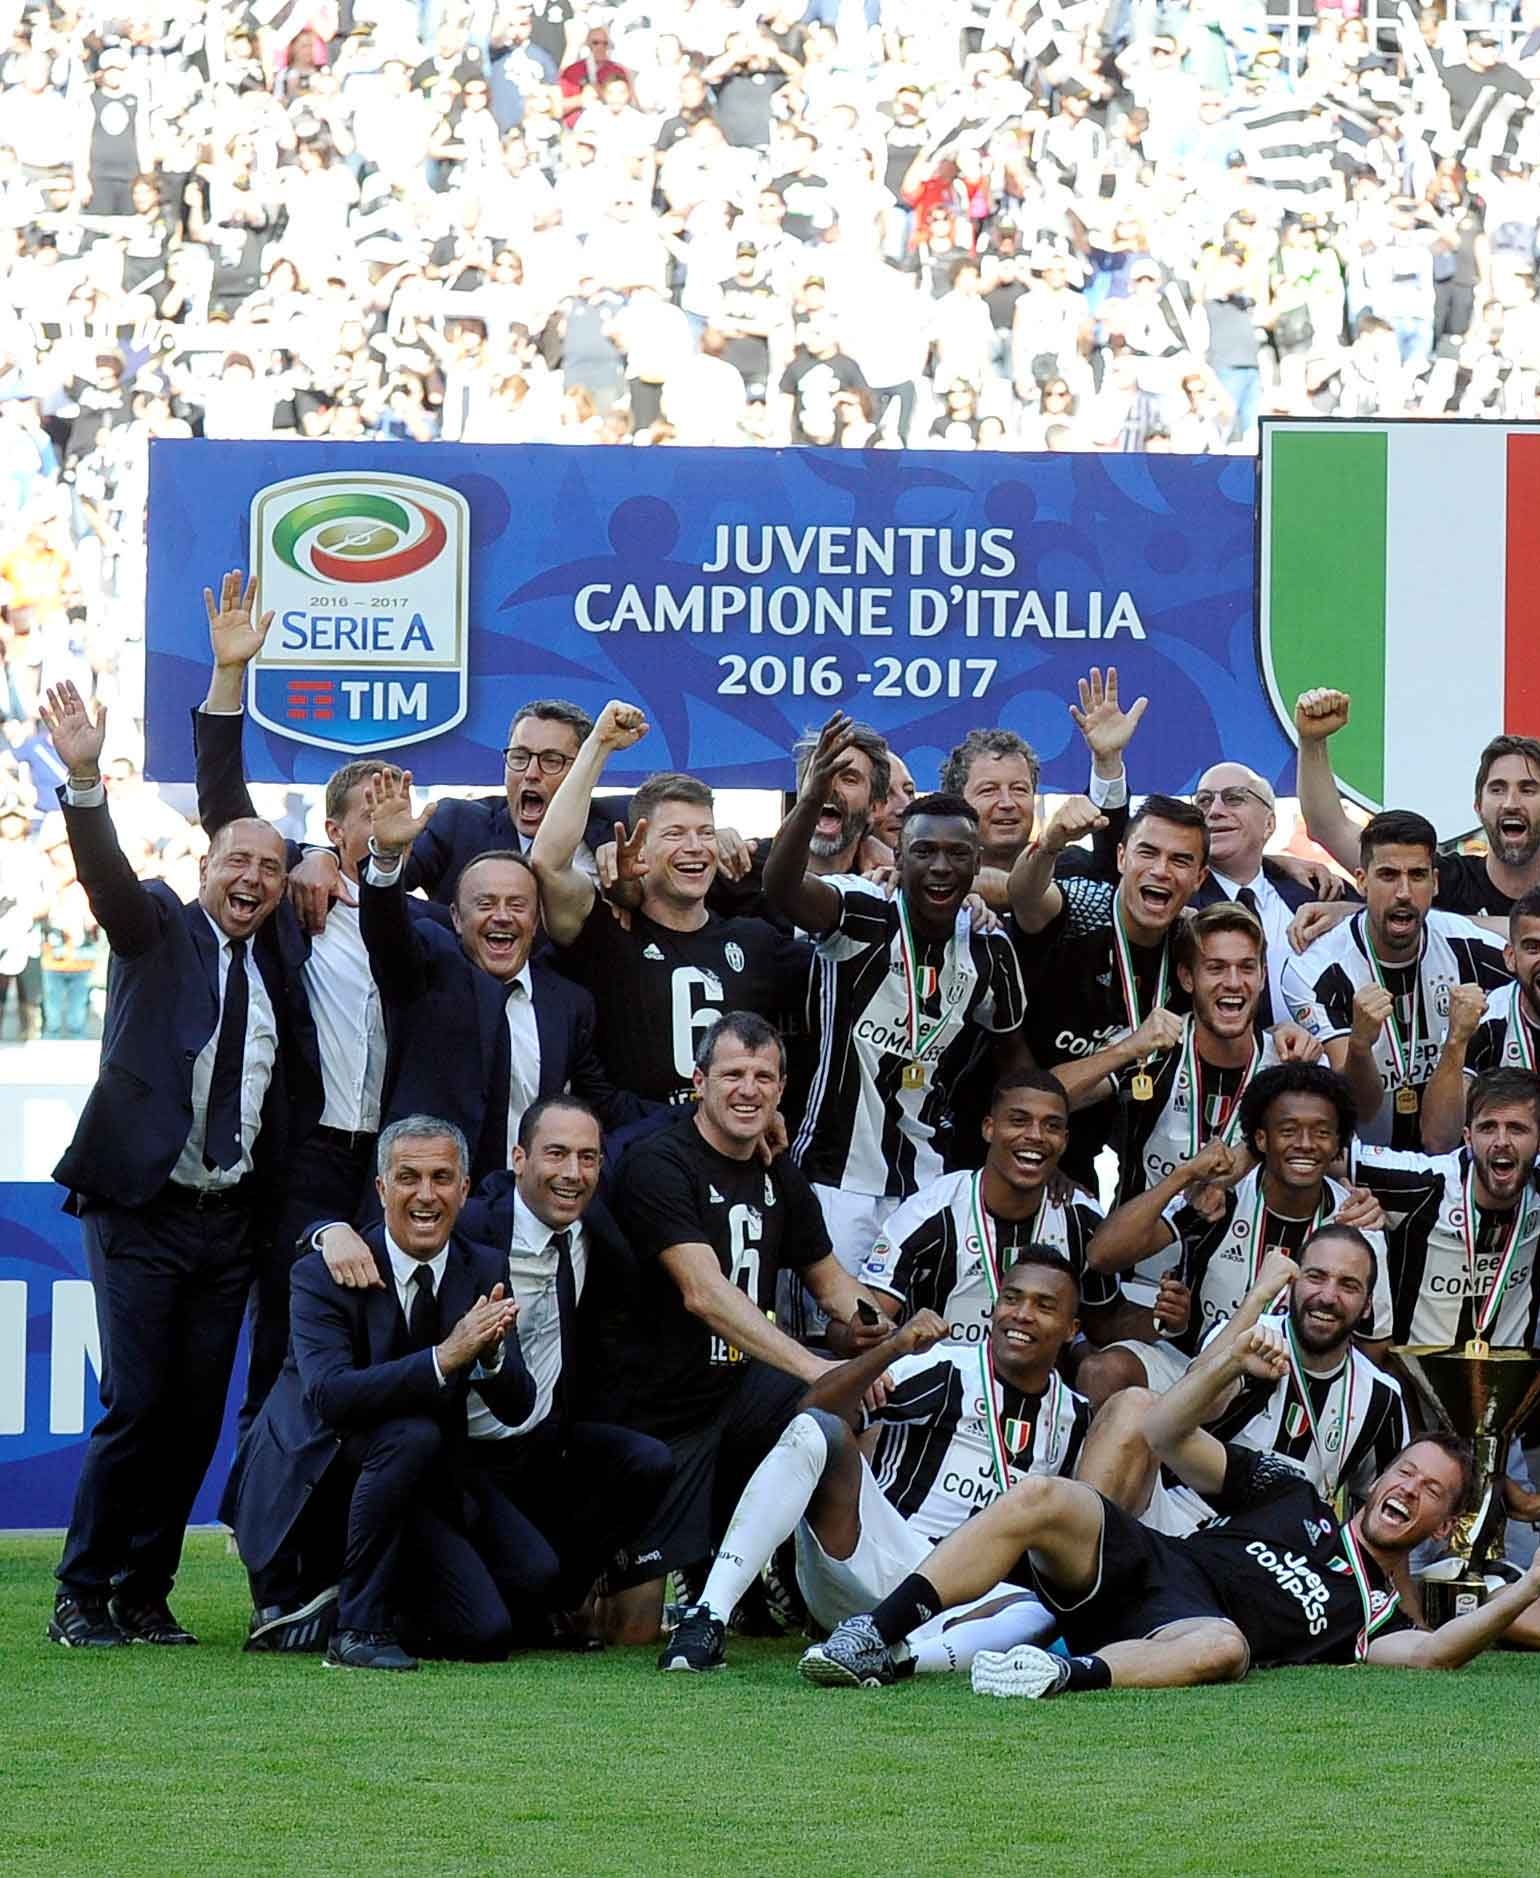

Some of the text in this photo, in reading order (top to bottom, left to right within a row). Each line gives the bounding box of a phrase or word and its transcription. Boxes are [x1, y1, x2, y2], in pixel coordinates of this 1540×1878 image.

[702, 525, 1016, 577] JUVENTUS
[310, 597, 348, 607] 2016
[371, 598, 409, 608] 2017
[574, 584, 1147, 640] CAMPIONE D'ITALIA
[282, 611, 435, 651] SERIE A
[717, 654, 842, 695] 2016
[341, 681, 428, 721] TIM
[1245, 1541, 1328, 1635] COMPASS
[1284, 1551, 1330, 1603] Jeep
